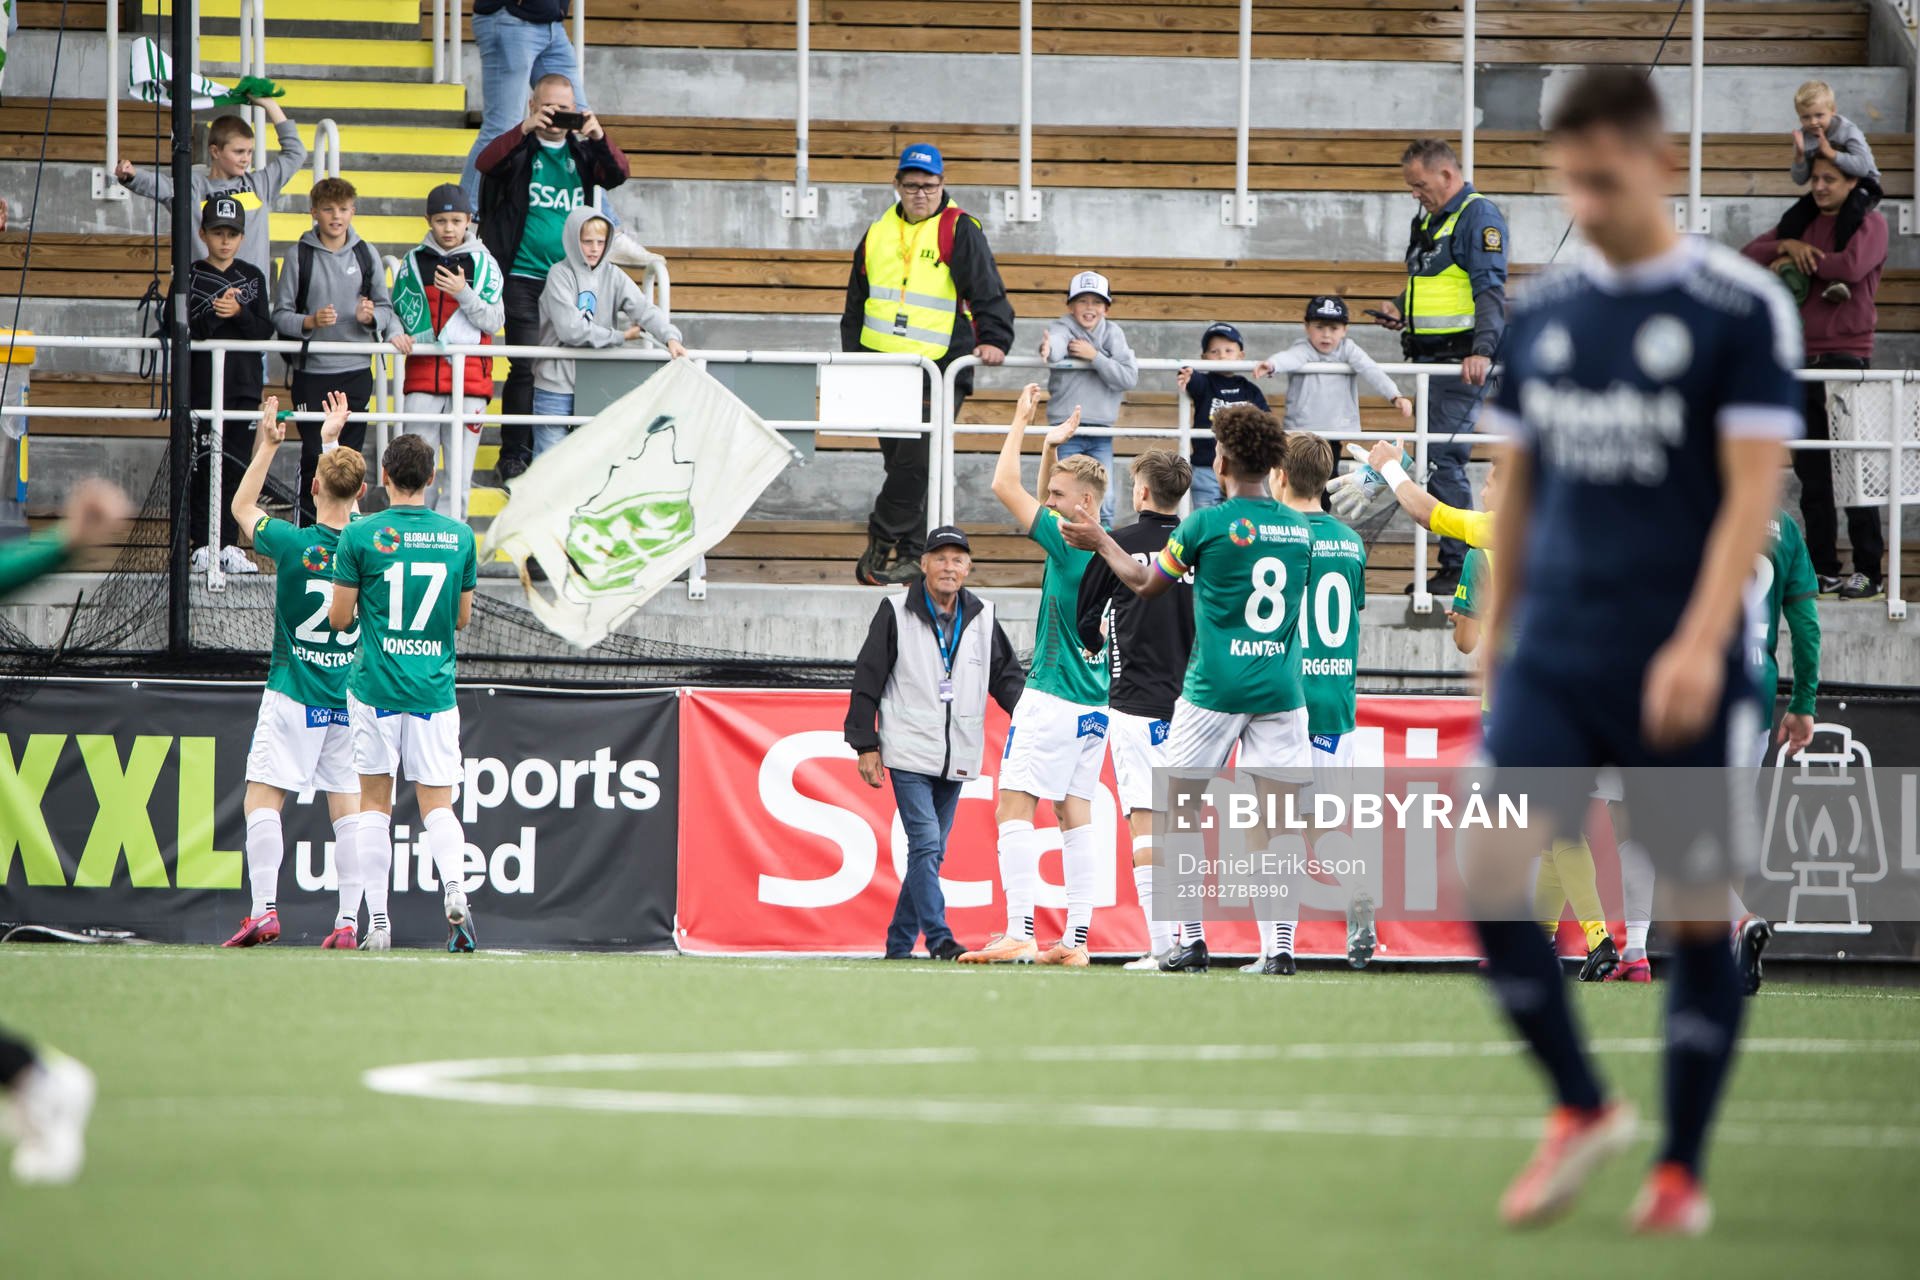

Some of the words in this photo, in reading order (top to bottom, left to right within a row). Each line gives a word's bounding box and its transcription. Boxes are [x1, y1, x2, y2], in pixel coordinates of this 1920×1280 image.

[529, 182, 585, 212] SSAB
[404, 531, 435, 542] GLOBALA
[437, 531, 458, 543] MÅLEN
[1313, 540, 1339, 551] LOBALA
[384, 561, 448, 631] 17
[1244, 556, 1287, 634] 8
[1302, 658, 1352, 675] RGGREN
[0, 732, 243, 889] XXL
[453, 746, 661, 823] ports
[295, 825, 536, 894] uited
